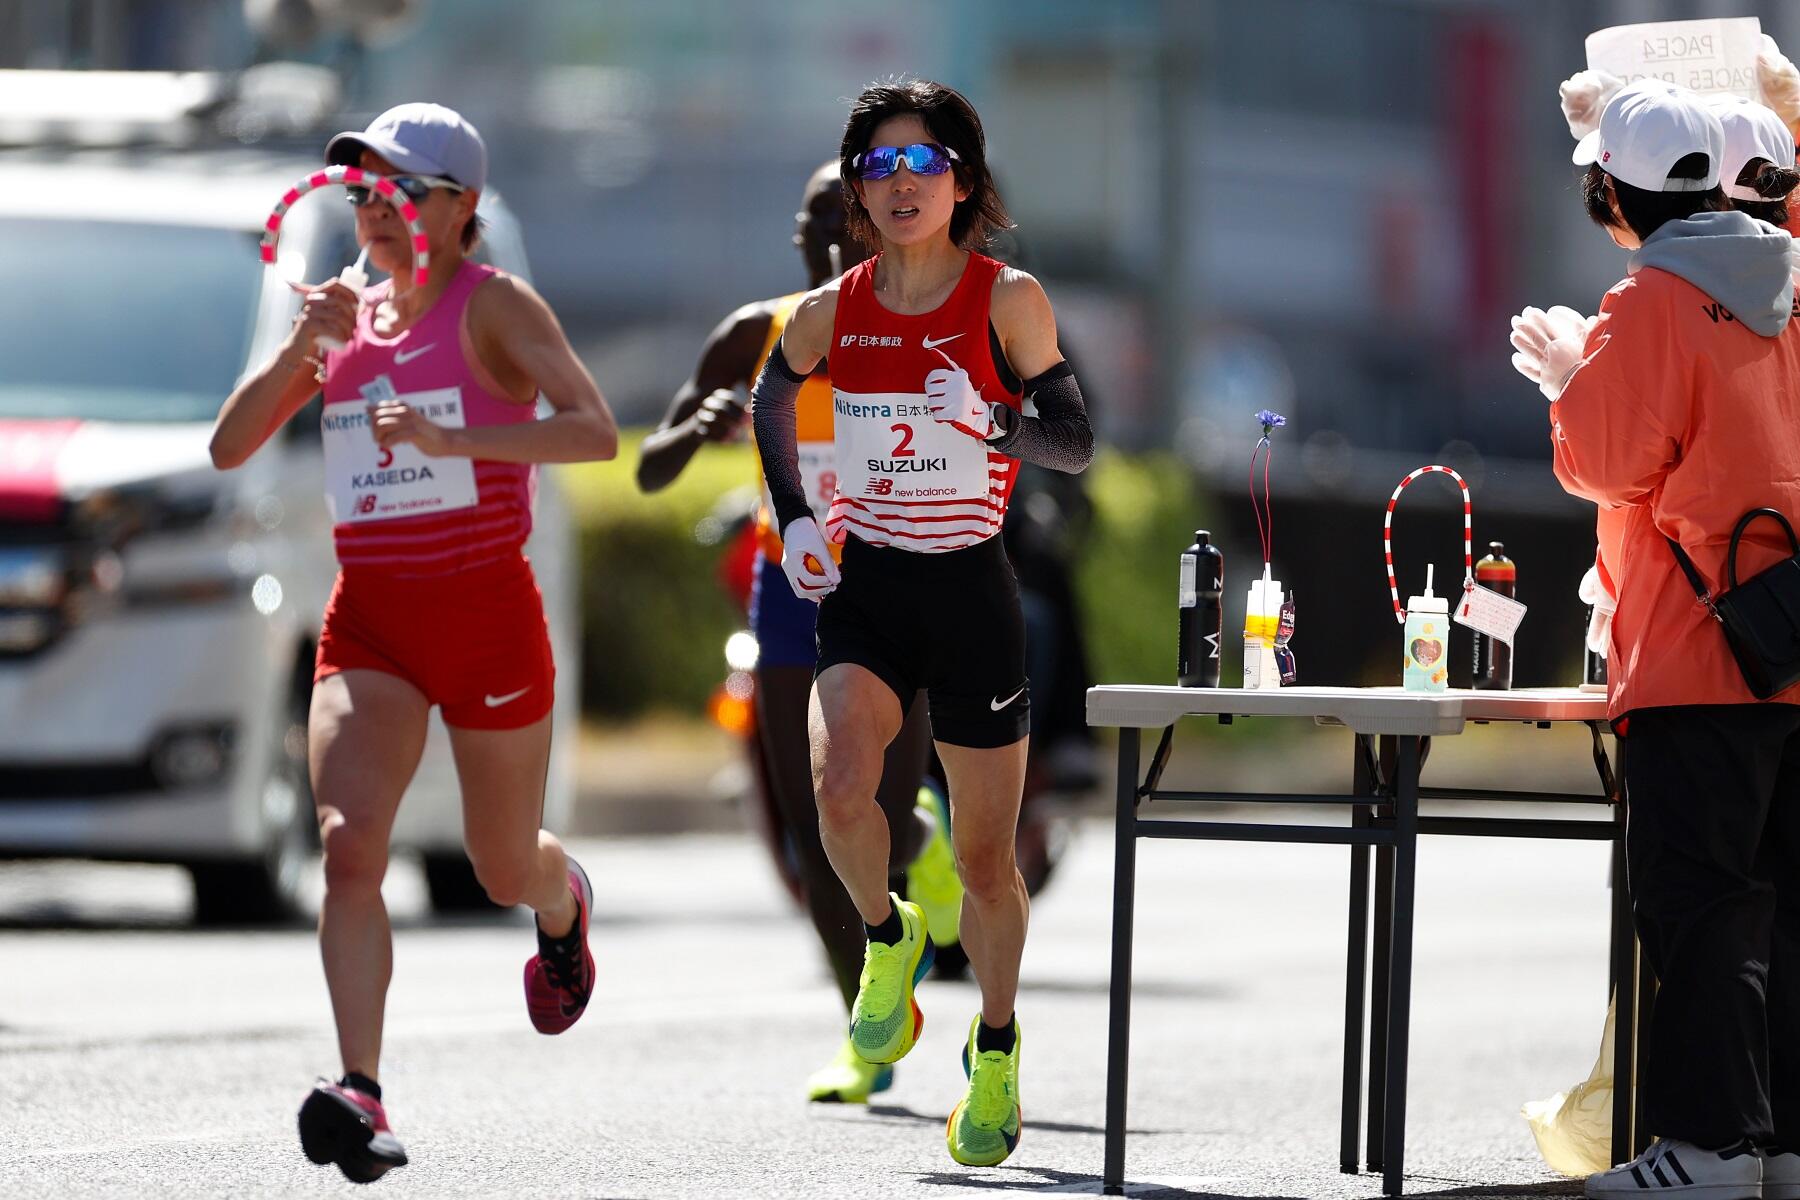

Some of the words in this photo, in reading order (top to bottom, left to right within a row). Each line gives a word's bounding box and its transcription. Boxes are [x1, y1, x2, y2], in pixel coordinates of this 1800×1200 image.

[858, 335, 903, 348] 日本郵政
[835, 398, 891, 419] Niterra
[890, 423, 916, 458] 2
[867, 458, 947, 473] SUZUKI
[352, 467, 434, 489] KASEDA
[895, 489, 914, 497] new
[916, 487, 957, 497] balance
